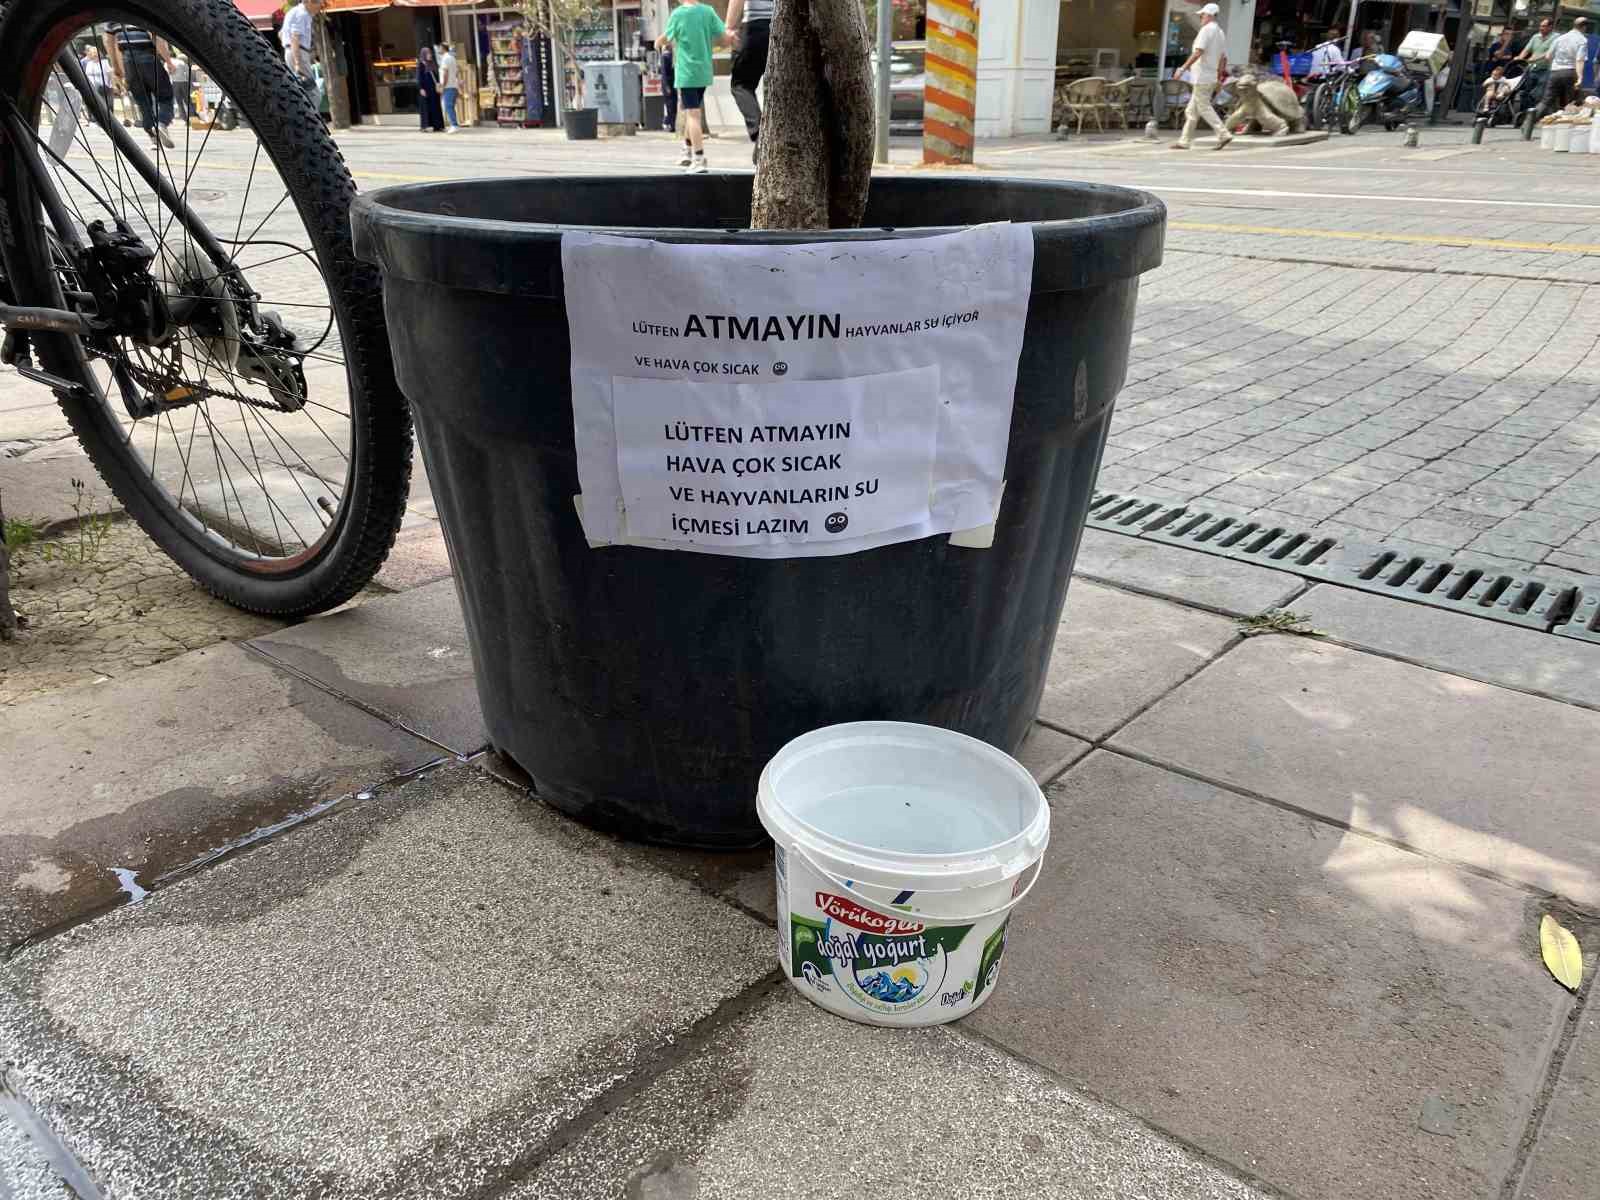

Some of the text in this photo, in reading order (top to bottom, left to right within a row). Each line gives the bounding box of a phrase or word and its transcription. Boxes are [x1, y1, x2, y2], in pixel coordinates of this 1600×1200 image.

[632, 319, 680, 338] LÜTFEN
[683, 313, 841, 342] ATMAYIN
[845, 320, 922, 339] HAYVANLAR
[923, 317, 940, 330] SU
[634, 355, 760, 376] VE HAVA ÇOK SICAK
[664, 421, 851, 444] LÜTFEN ATMAYIN
[666, 453, 842, 478] HAVA ÇOK SICAK
[668, 478, 880, 506] VE HAYVANLARIN SU
[671, 513, 809, 536] İÇMESİ LAZIM
[862, 934, 928, 967] yoğurt
